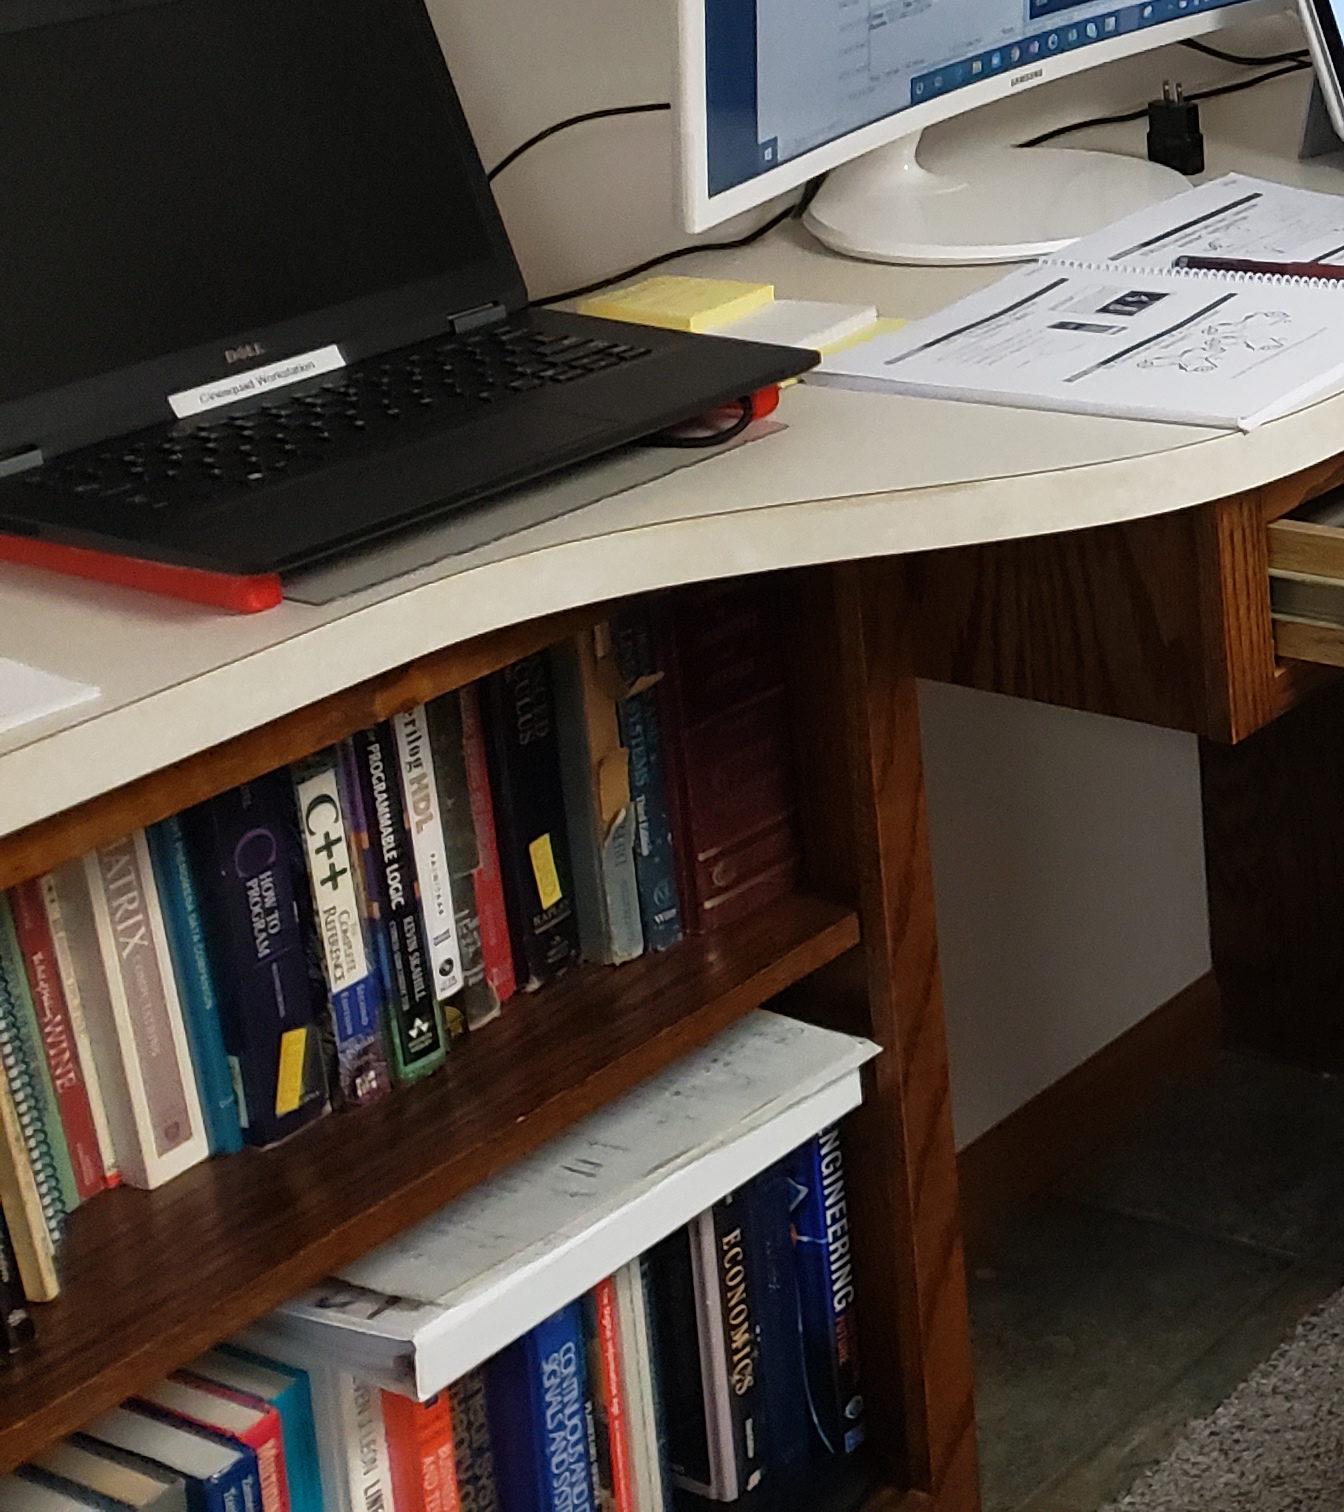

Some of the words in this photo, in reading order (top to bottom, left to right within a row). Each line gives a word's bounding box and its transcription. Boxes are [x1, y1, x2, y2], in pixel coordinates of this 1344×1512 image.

[225, 343, 266, 363] DELL
[255, 359, 316, 387] Workstation
[366, 743, 399, 864] PROGRAMMABLE
[385, 863, 406, 912] LOGIC
[408, 772, 434, 835] HDL
[304, 793, 348, 892] C++
[246, 877, 272, 960] PROGRAM
[259, 871, 279, 907] HOW
[267, 913, 283, 936] TO
[322, 905, 347, 985] REFERENCE
[338, 909, 360, 975] COMPLETE
[42, 1014, 78, 1093] WINE
[721, 1228, 755, 1396] ECONOMICS
[541, 1352, 563, 1430] SIGNALS
[558, 1341, 586, 1463] CONTINUOUS
[548, 1432, 569, 1475] AND
[569, 1462, 589, 1505] AND
